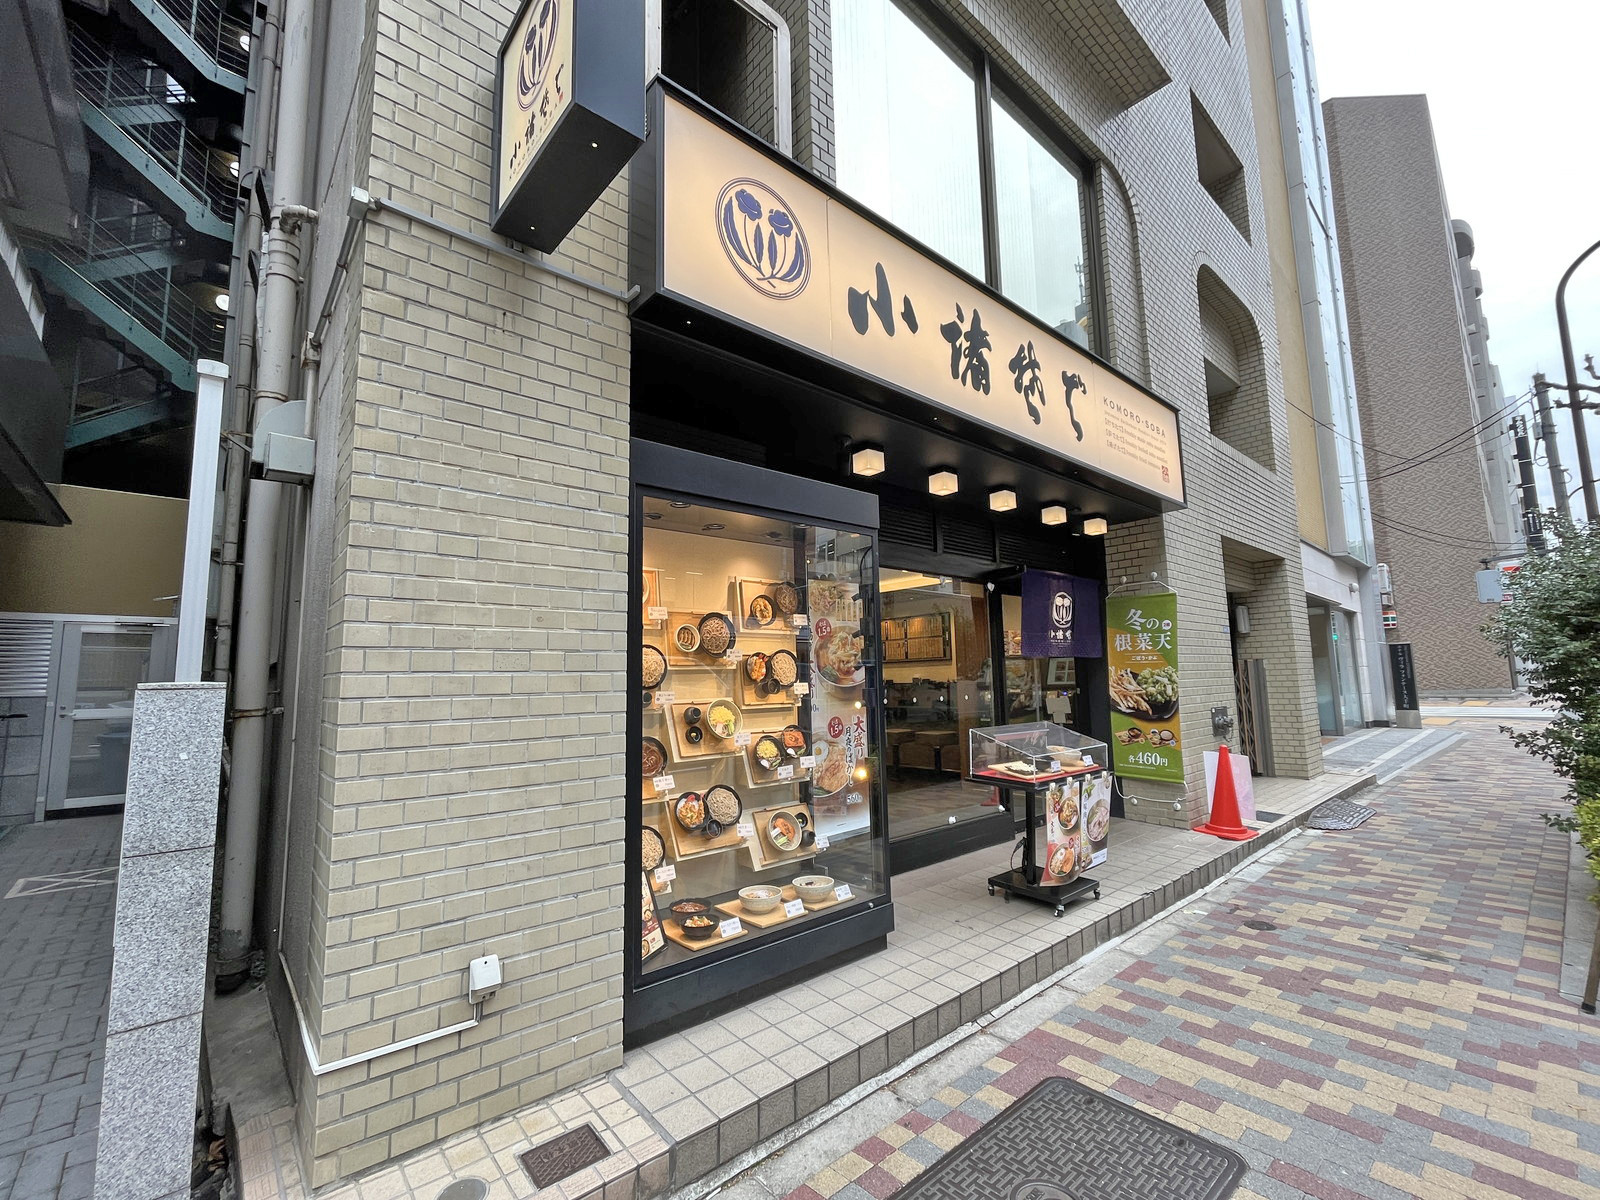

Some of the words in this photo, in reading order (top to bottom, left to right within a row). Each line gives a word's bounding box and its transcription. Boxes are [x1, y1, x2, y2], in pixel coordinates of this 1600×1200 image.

[1125, 608, 1159, 631] 冬の
[1114, 632, 1172, 652] 根菜天
[853, 715, 866, 758] 大盛り
